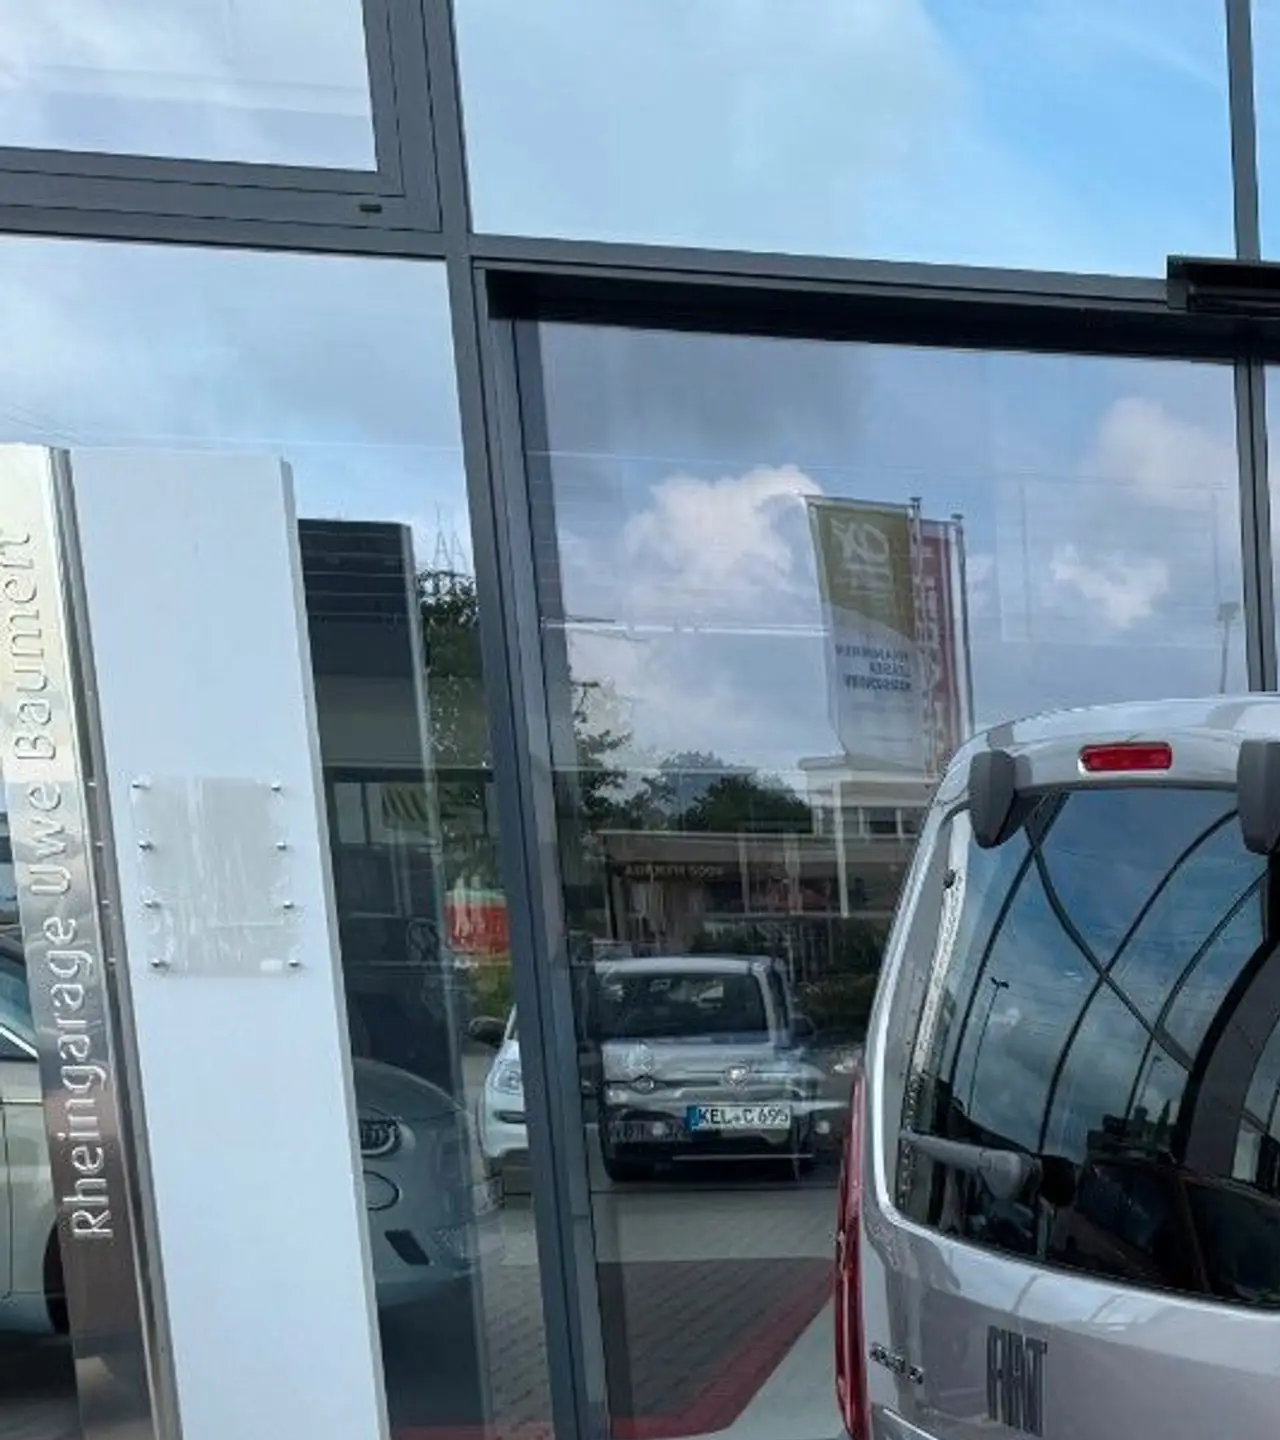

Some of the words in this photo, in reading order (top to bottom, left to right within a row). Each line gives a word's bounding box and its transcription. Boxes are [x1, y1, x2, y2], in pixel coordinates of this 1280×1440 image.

[0, 531, 57, 761] Baumert
[28, 786, 71, 896] Uwe
[42, 915, 113, 1239] Rheingarage
[986, 1325, 1048, 1438] FIAT
